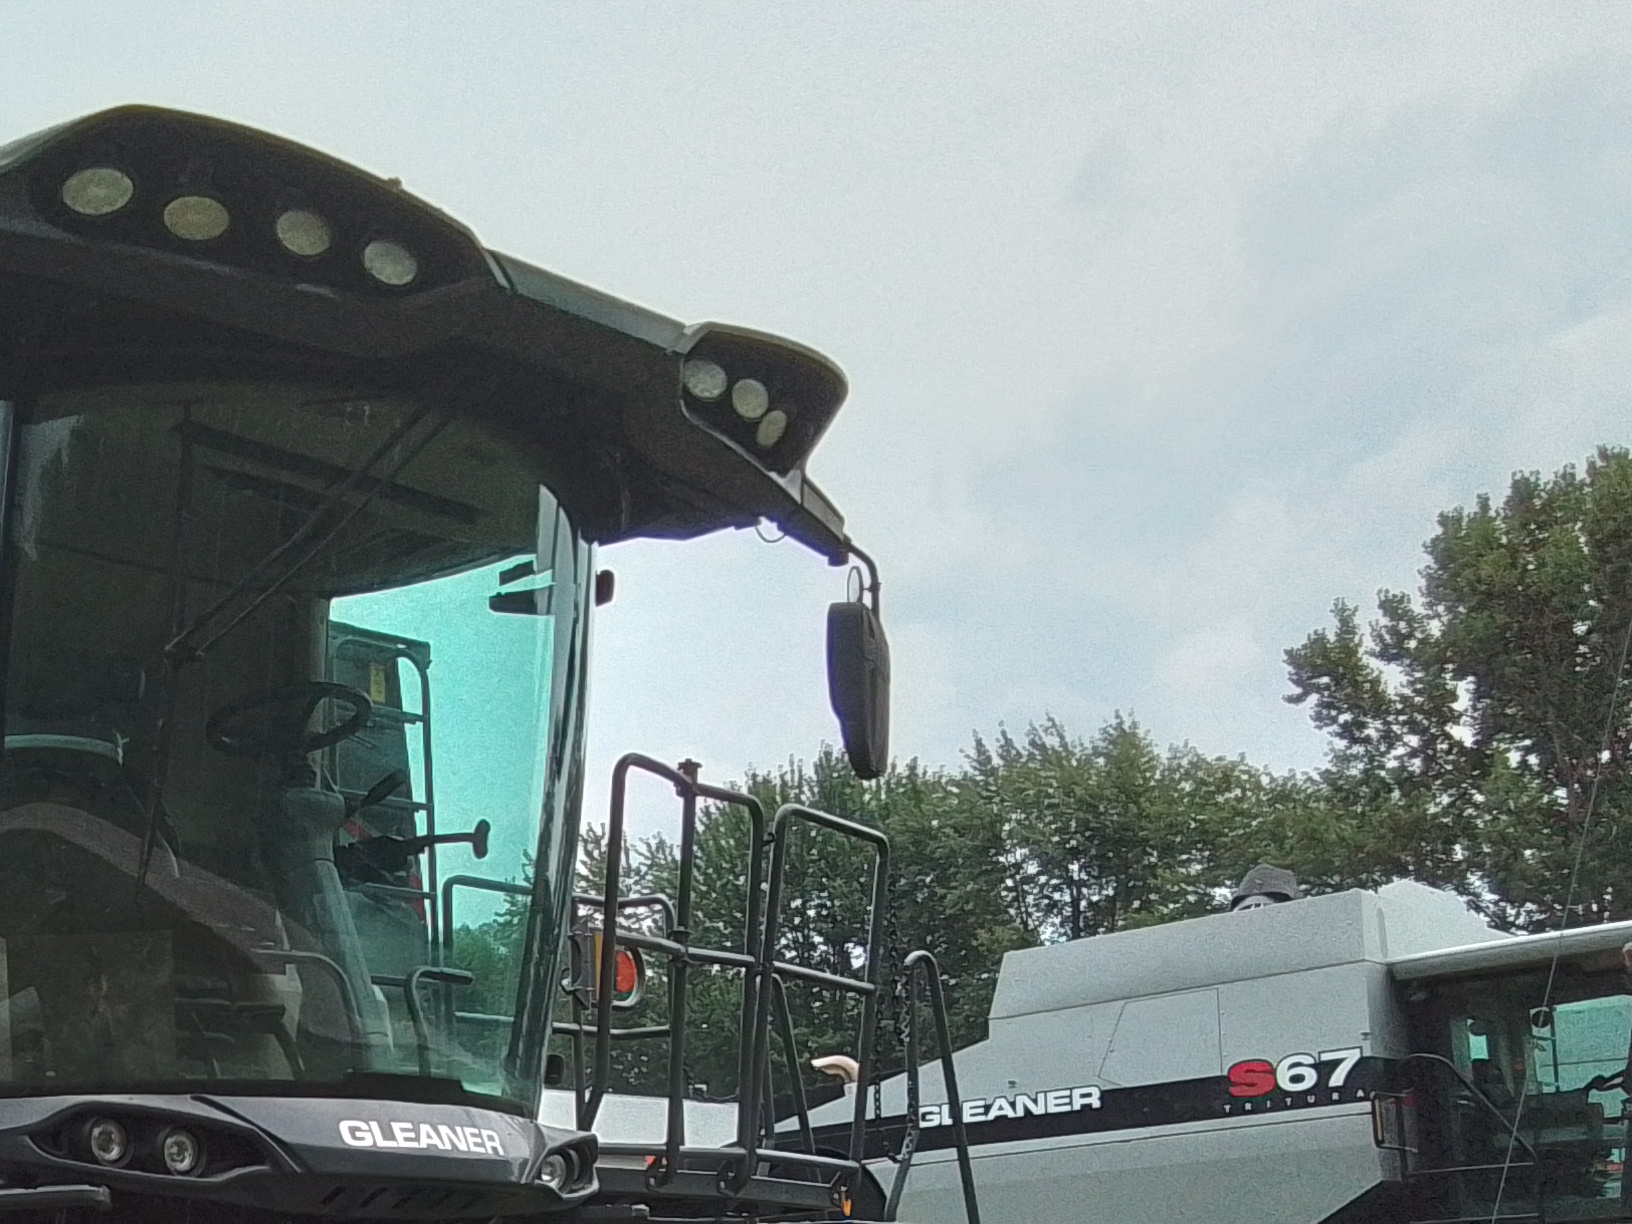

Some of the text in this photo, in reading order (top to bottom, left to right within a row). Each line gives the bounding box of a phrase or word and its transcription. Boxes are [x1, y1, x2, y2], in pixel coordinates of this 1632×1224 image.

[1227, 1046, 1363, 1098] S67
[919, 1085, 1102, 1129] GLEANER
[1223, 1089, 1365, 1113] TRITURA
[339, 1119, 504, 1155] GLEANER
